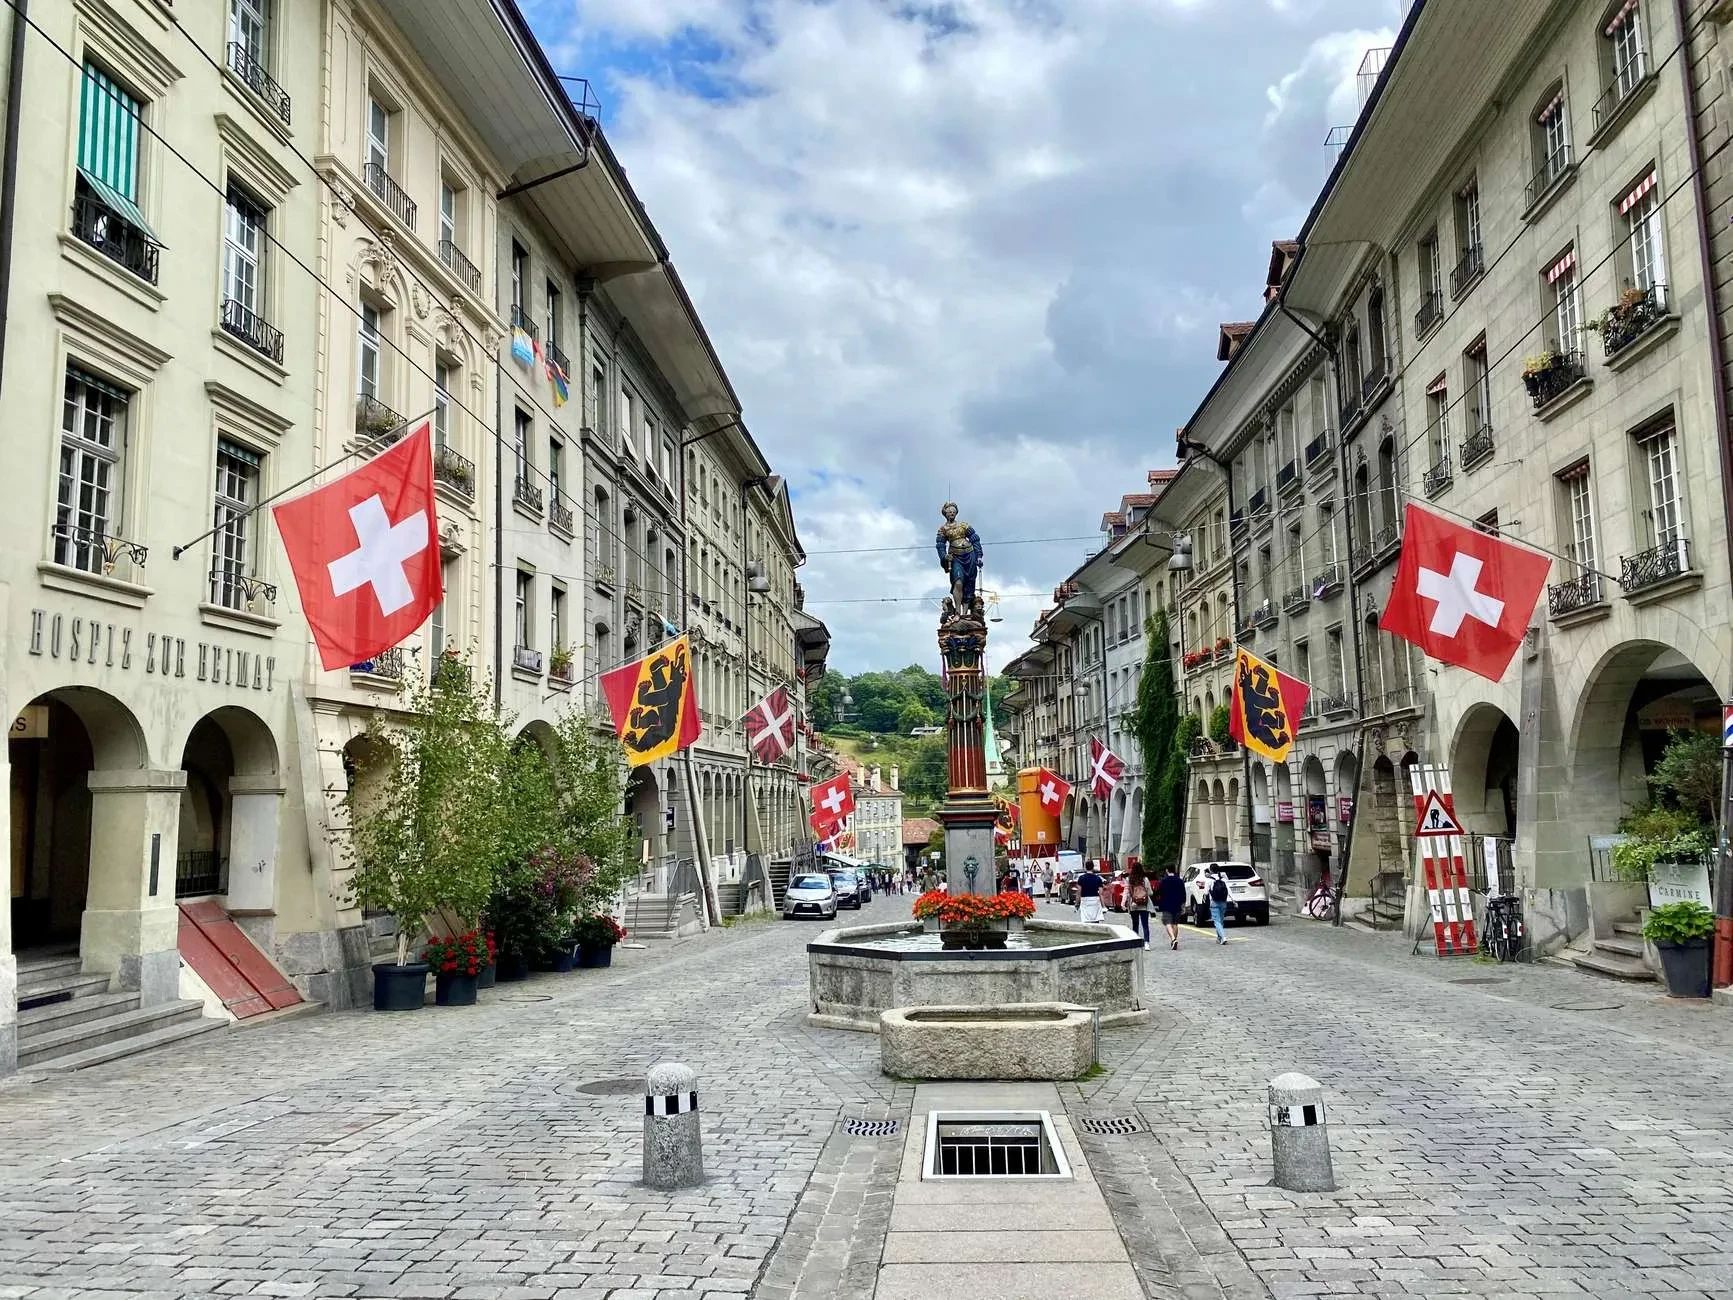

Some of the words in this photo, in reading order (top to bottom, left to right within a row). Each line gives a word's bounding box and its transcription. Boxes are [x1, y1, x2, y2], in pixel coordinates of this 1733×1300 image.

[28, 608, 132, 669] HOSPIZ
[146, 632, 185, 678] ZUR
[197, 642, 276, 692] HEIMAT
[1658, 886, 1701, 900] CARMINE
